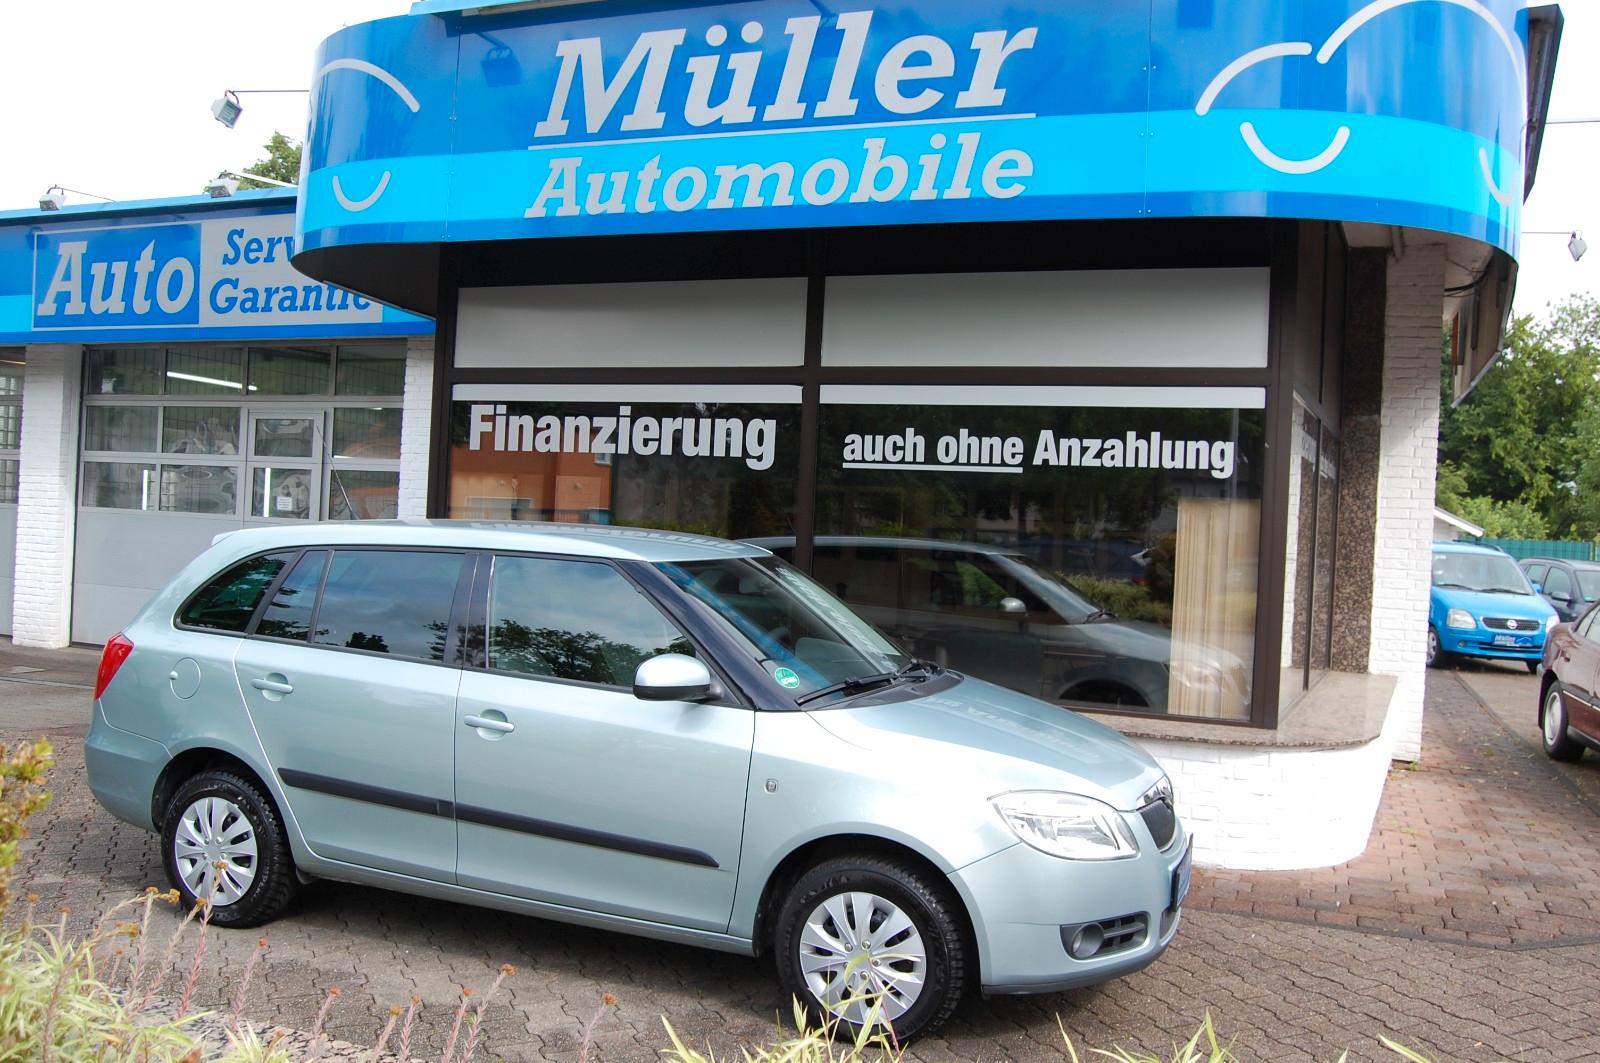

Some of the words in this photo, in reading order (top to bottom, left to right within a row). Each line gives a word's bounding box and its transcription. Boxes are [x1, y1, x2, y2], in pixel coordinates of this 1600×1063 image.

[533, 10, 1038, 138] Müller
[523, 132, 1035, 218] Automobile
[37, 240, 195, 316] Auto
[469, 404, 777, 471] Finanzierung
[842, 427, 926, 464] auch
[936, 428, 1024, 466] ohne
[1032, 429, 1235, 480] Anzahlung
